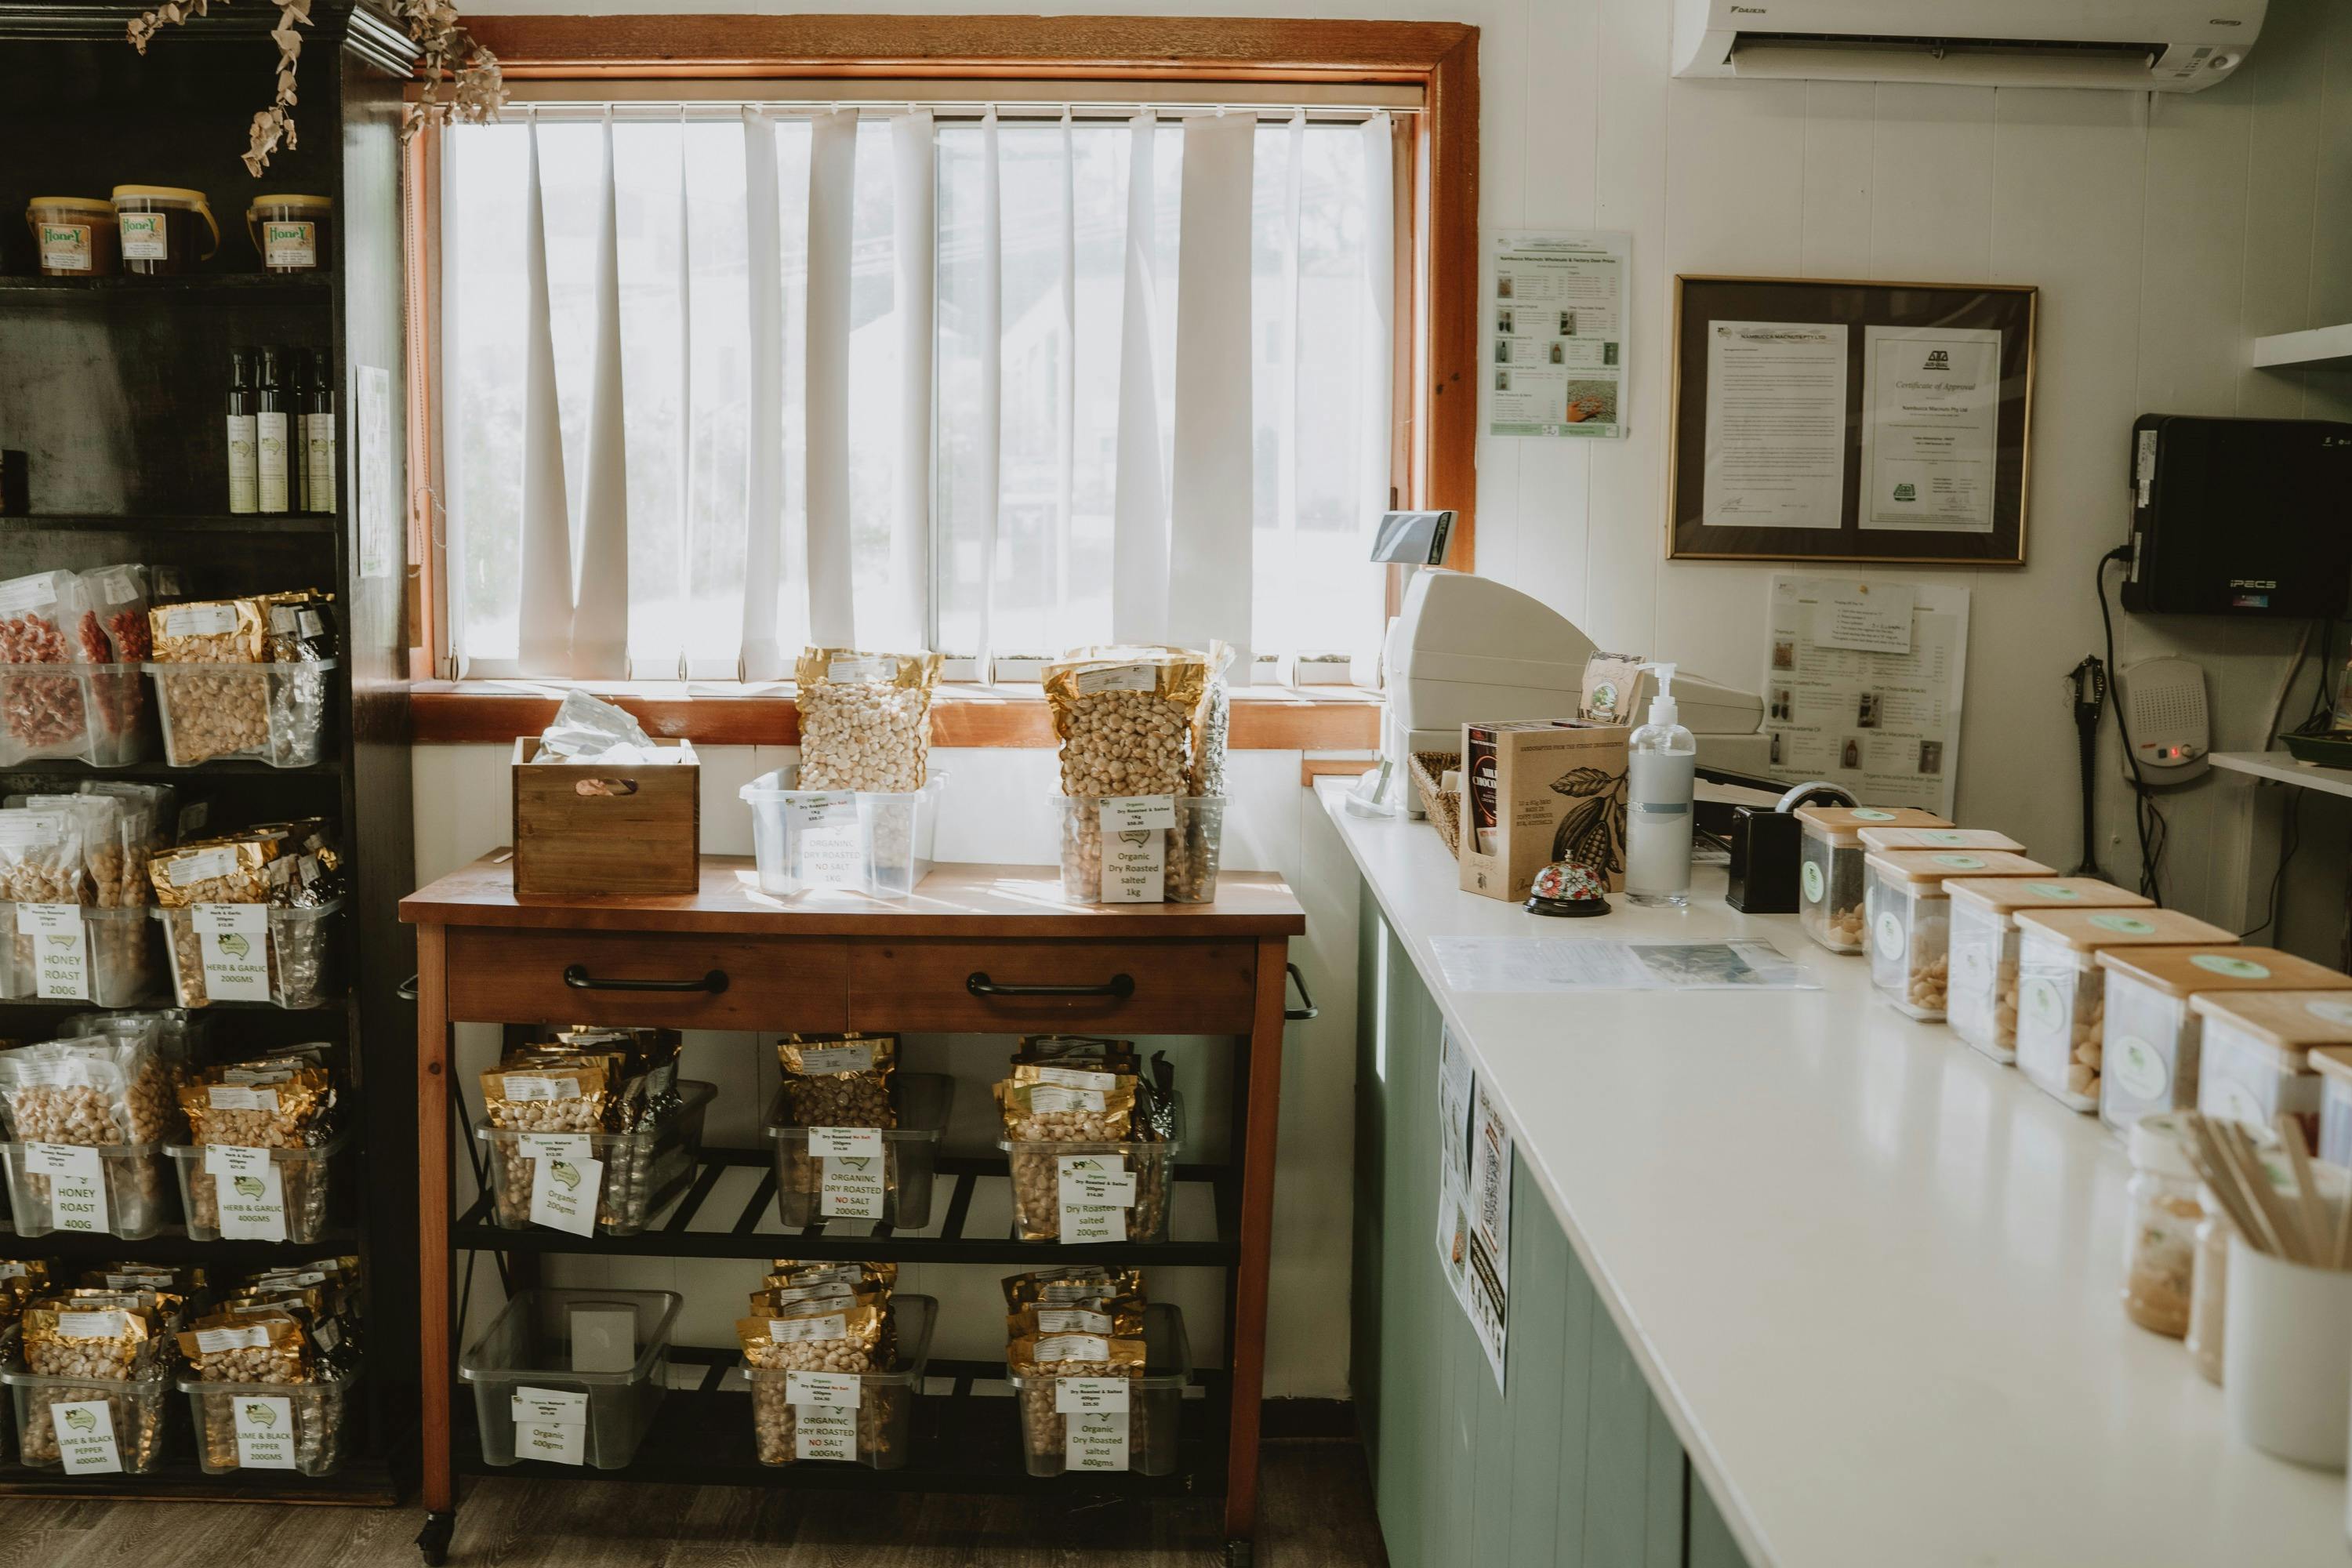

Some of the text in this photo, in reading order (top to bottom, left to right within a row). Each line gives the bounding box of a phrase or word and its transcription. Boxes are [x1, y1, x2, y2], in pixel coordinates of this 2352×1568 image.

[1896, 380, 1976, 392] Certificate of Approval
[2230, 579, 2277, 589] iPECS
[1482, 768, 1497, 778] MIL
[1472, 776, 1497, 789] CHOCO
[1117, 852, 1150, 862] Organic
[1127, 888, 1142, 897] 1kg
[44, 955, 82, 965] HONEY
[45, 970, 80, 980] ROAST
[49, 985, 77, 996] 200G
[831, 1174, 877, 1183] ORGANINC
[58, 1188, 95, 1198] HONEY
[843, 1185, 882, 1195] ROASTED
[548, 1190, 577, 1204] Organic
[60, 1203, 95, 1212] ROAST
[546, 1200, 576, 1215] 200gms
[835, 1207, 869, 1216] 200GMS
[1066, 1206, 1080, 1214] Dry
[64, 1220, 92, 1229] 400G
[1076, 1229, 1109, 1237] 200gms
[803, 1417, 849, 1425] ORGANINC
[533, 1429, 564, 1439] Organic
[816, 1428, 855, 1436] ROASTED
[1082, 1425, 1114, 1434] Organic
[89, 1435, 114, 1443] BLACK
[1073, 1436, 1087, 1445] Dry
[532, 1439, 564, 1450] 400gms
[1082, 1458, 1114, 1468] 400gms
